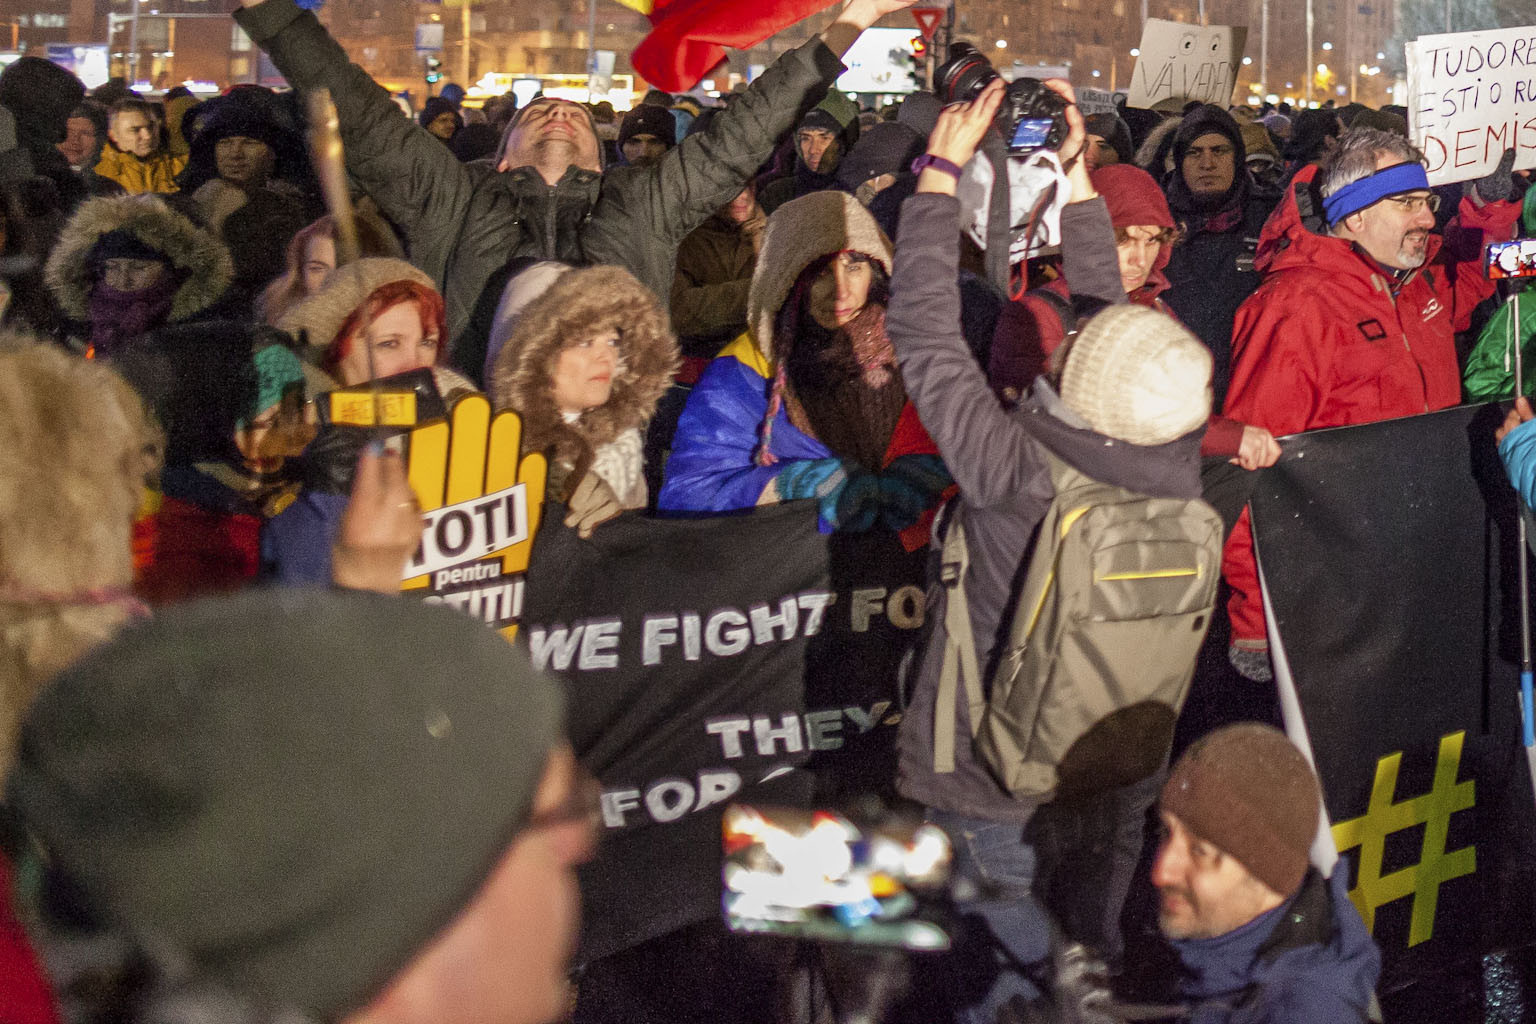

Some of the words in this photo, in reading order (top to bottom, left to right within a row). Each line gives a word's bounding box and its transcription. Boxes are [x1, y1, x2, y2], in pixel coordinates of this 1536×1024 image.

[1141, 56, 1176, 98] VĂ
[1490, 83, 1502, 104] O
[435, 561, 501, 590] pentru
[529, 617, 623, 671] WE
[642, 591, 837, 666] FIGHT
